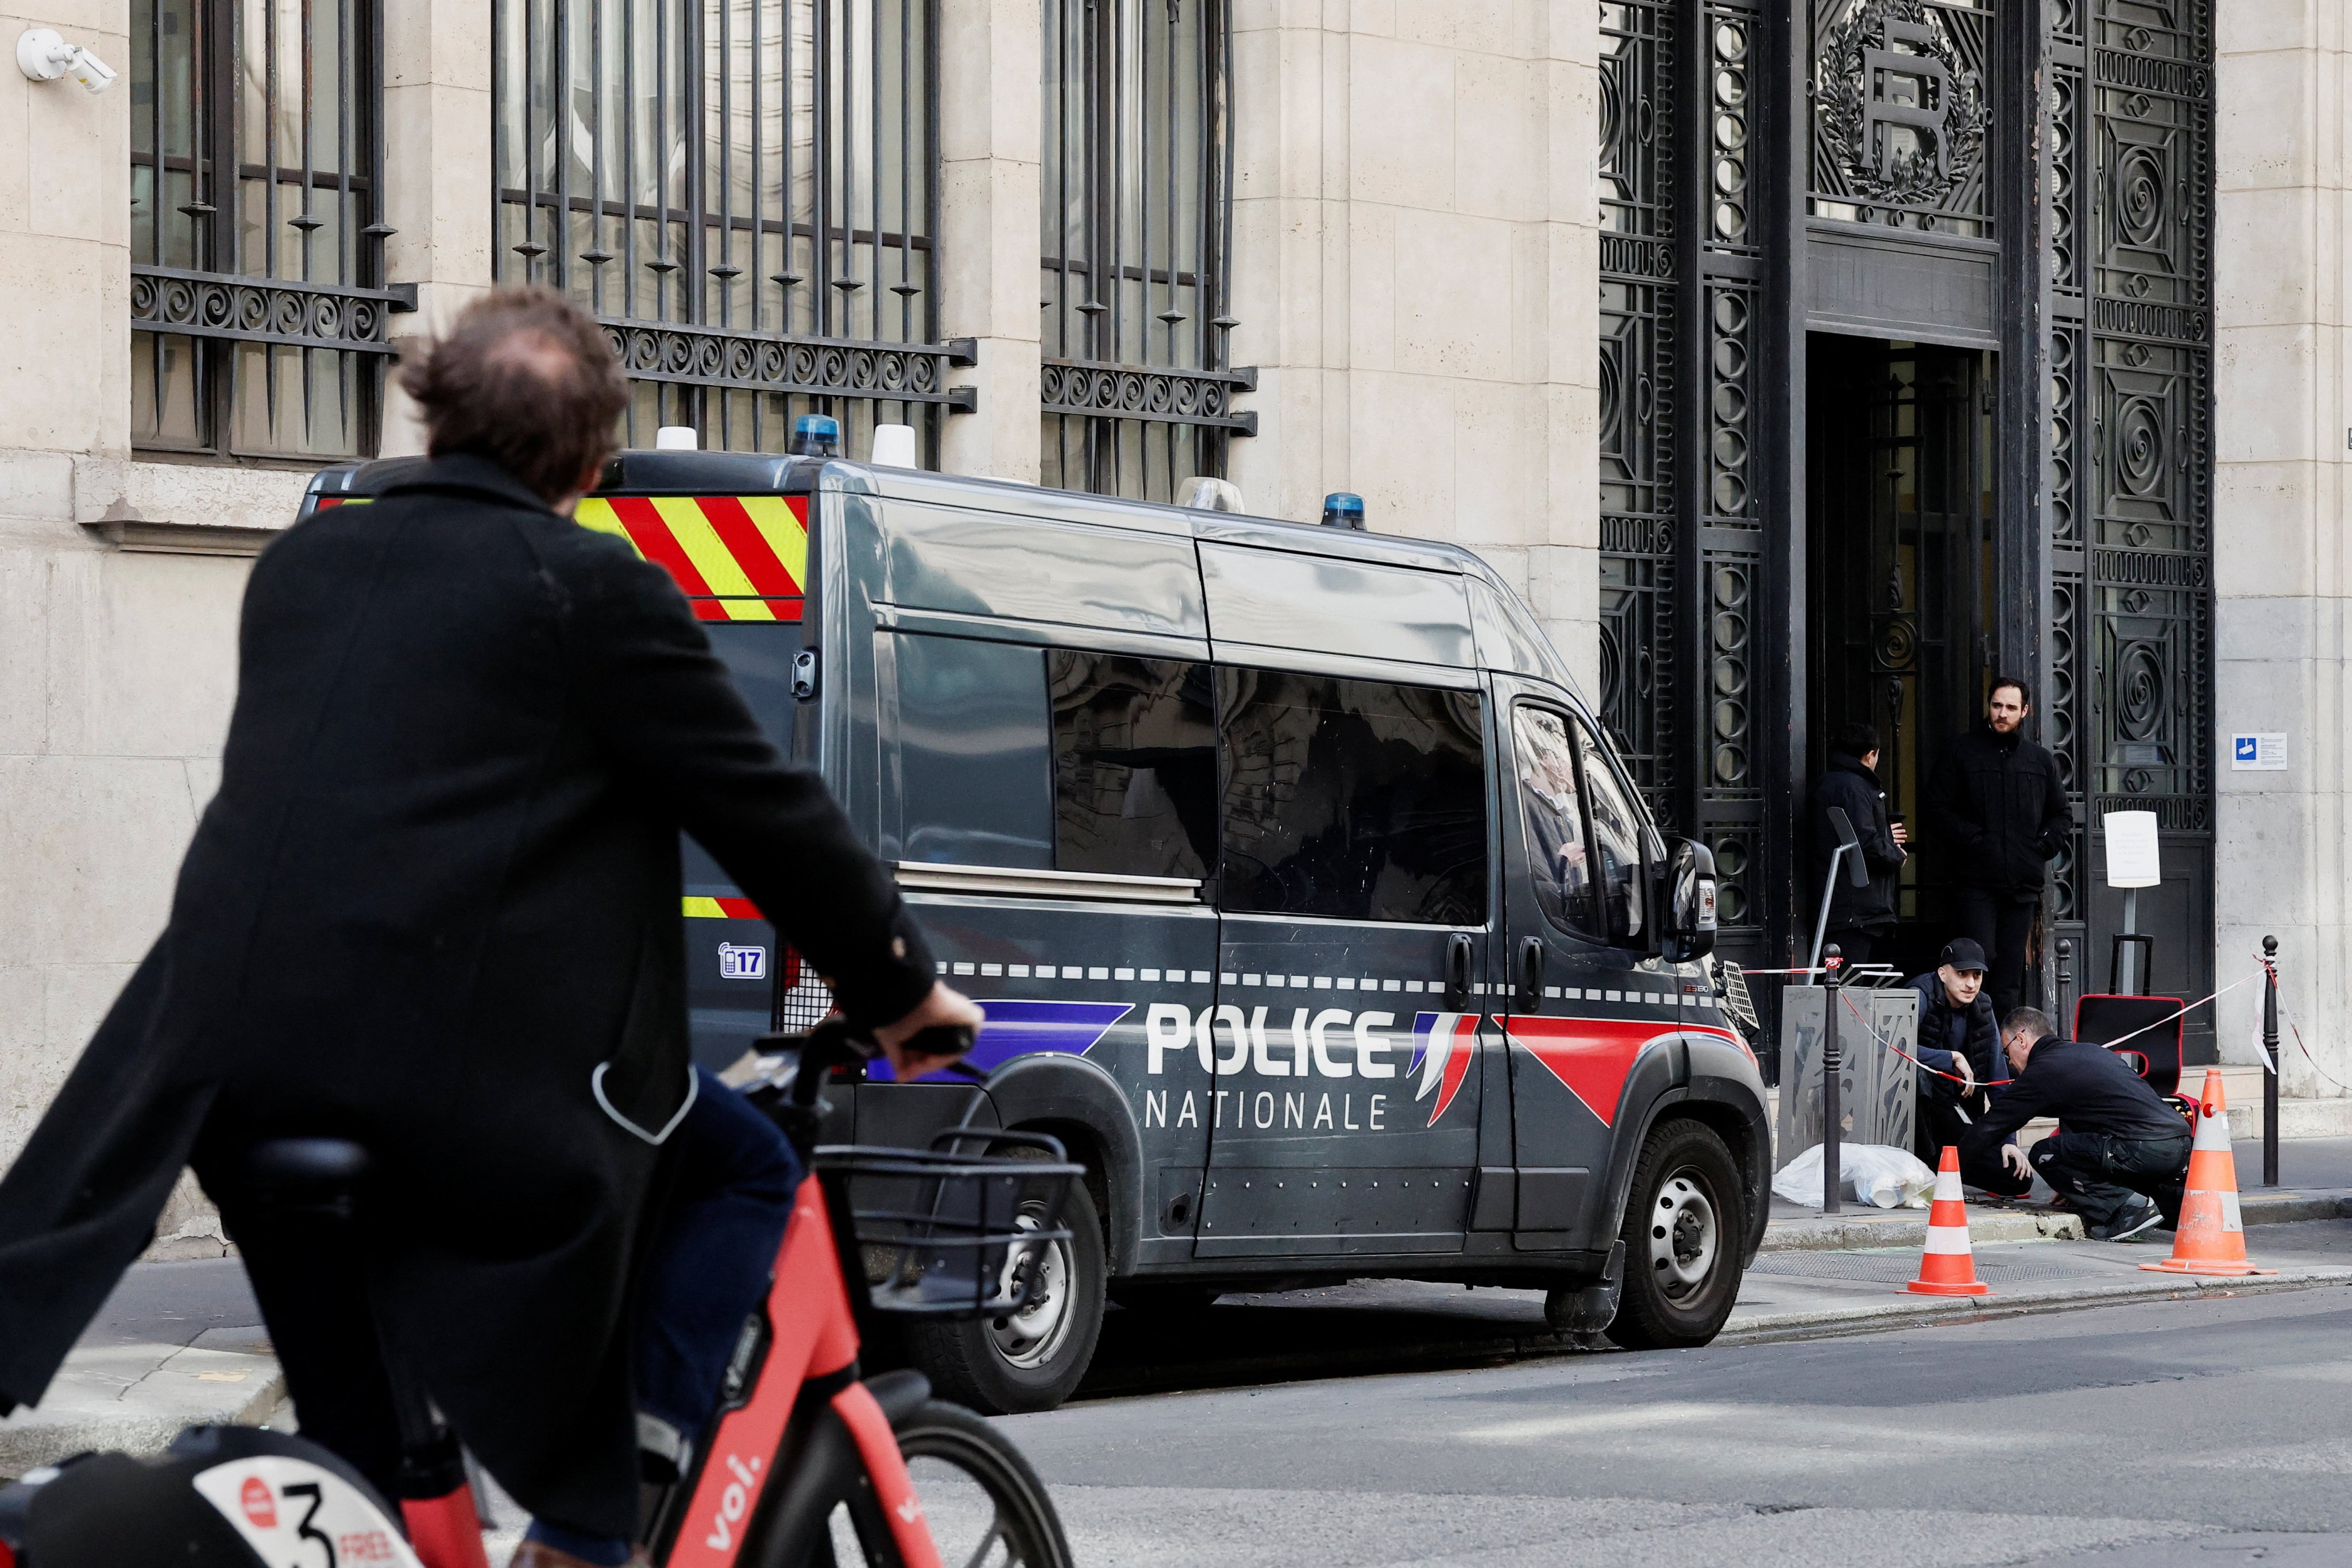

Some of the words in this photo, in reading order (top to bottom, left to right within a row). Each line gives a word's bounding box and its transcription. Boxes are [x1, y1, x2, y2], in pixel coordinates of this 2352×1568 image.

[737, 952, 760, 972] 17
[1145, 1003, 1396, 1079] POLICE
[1145, 1090, 1387, 1130] NATIONALE
[281, 1483, 335, 1568] 3
